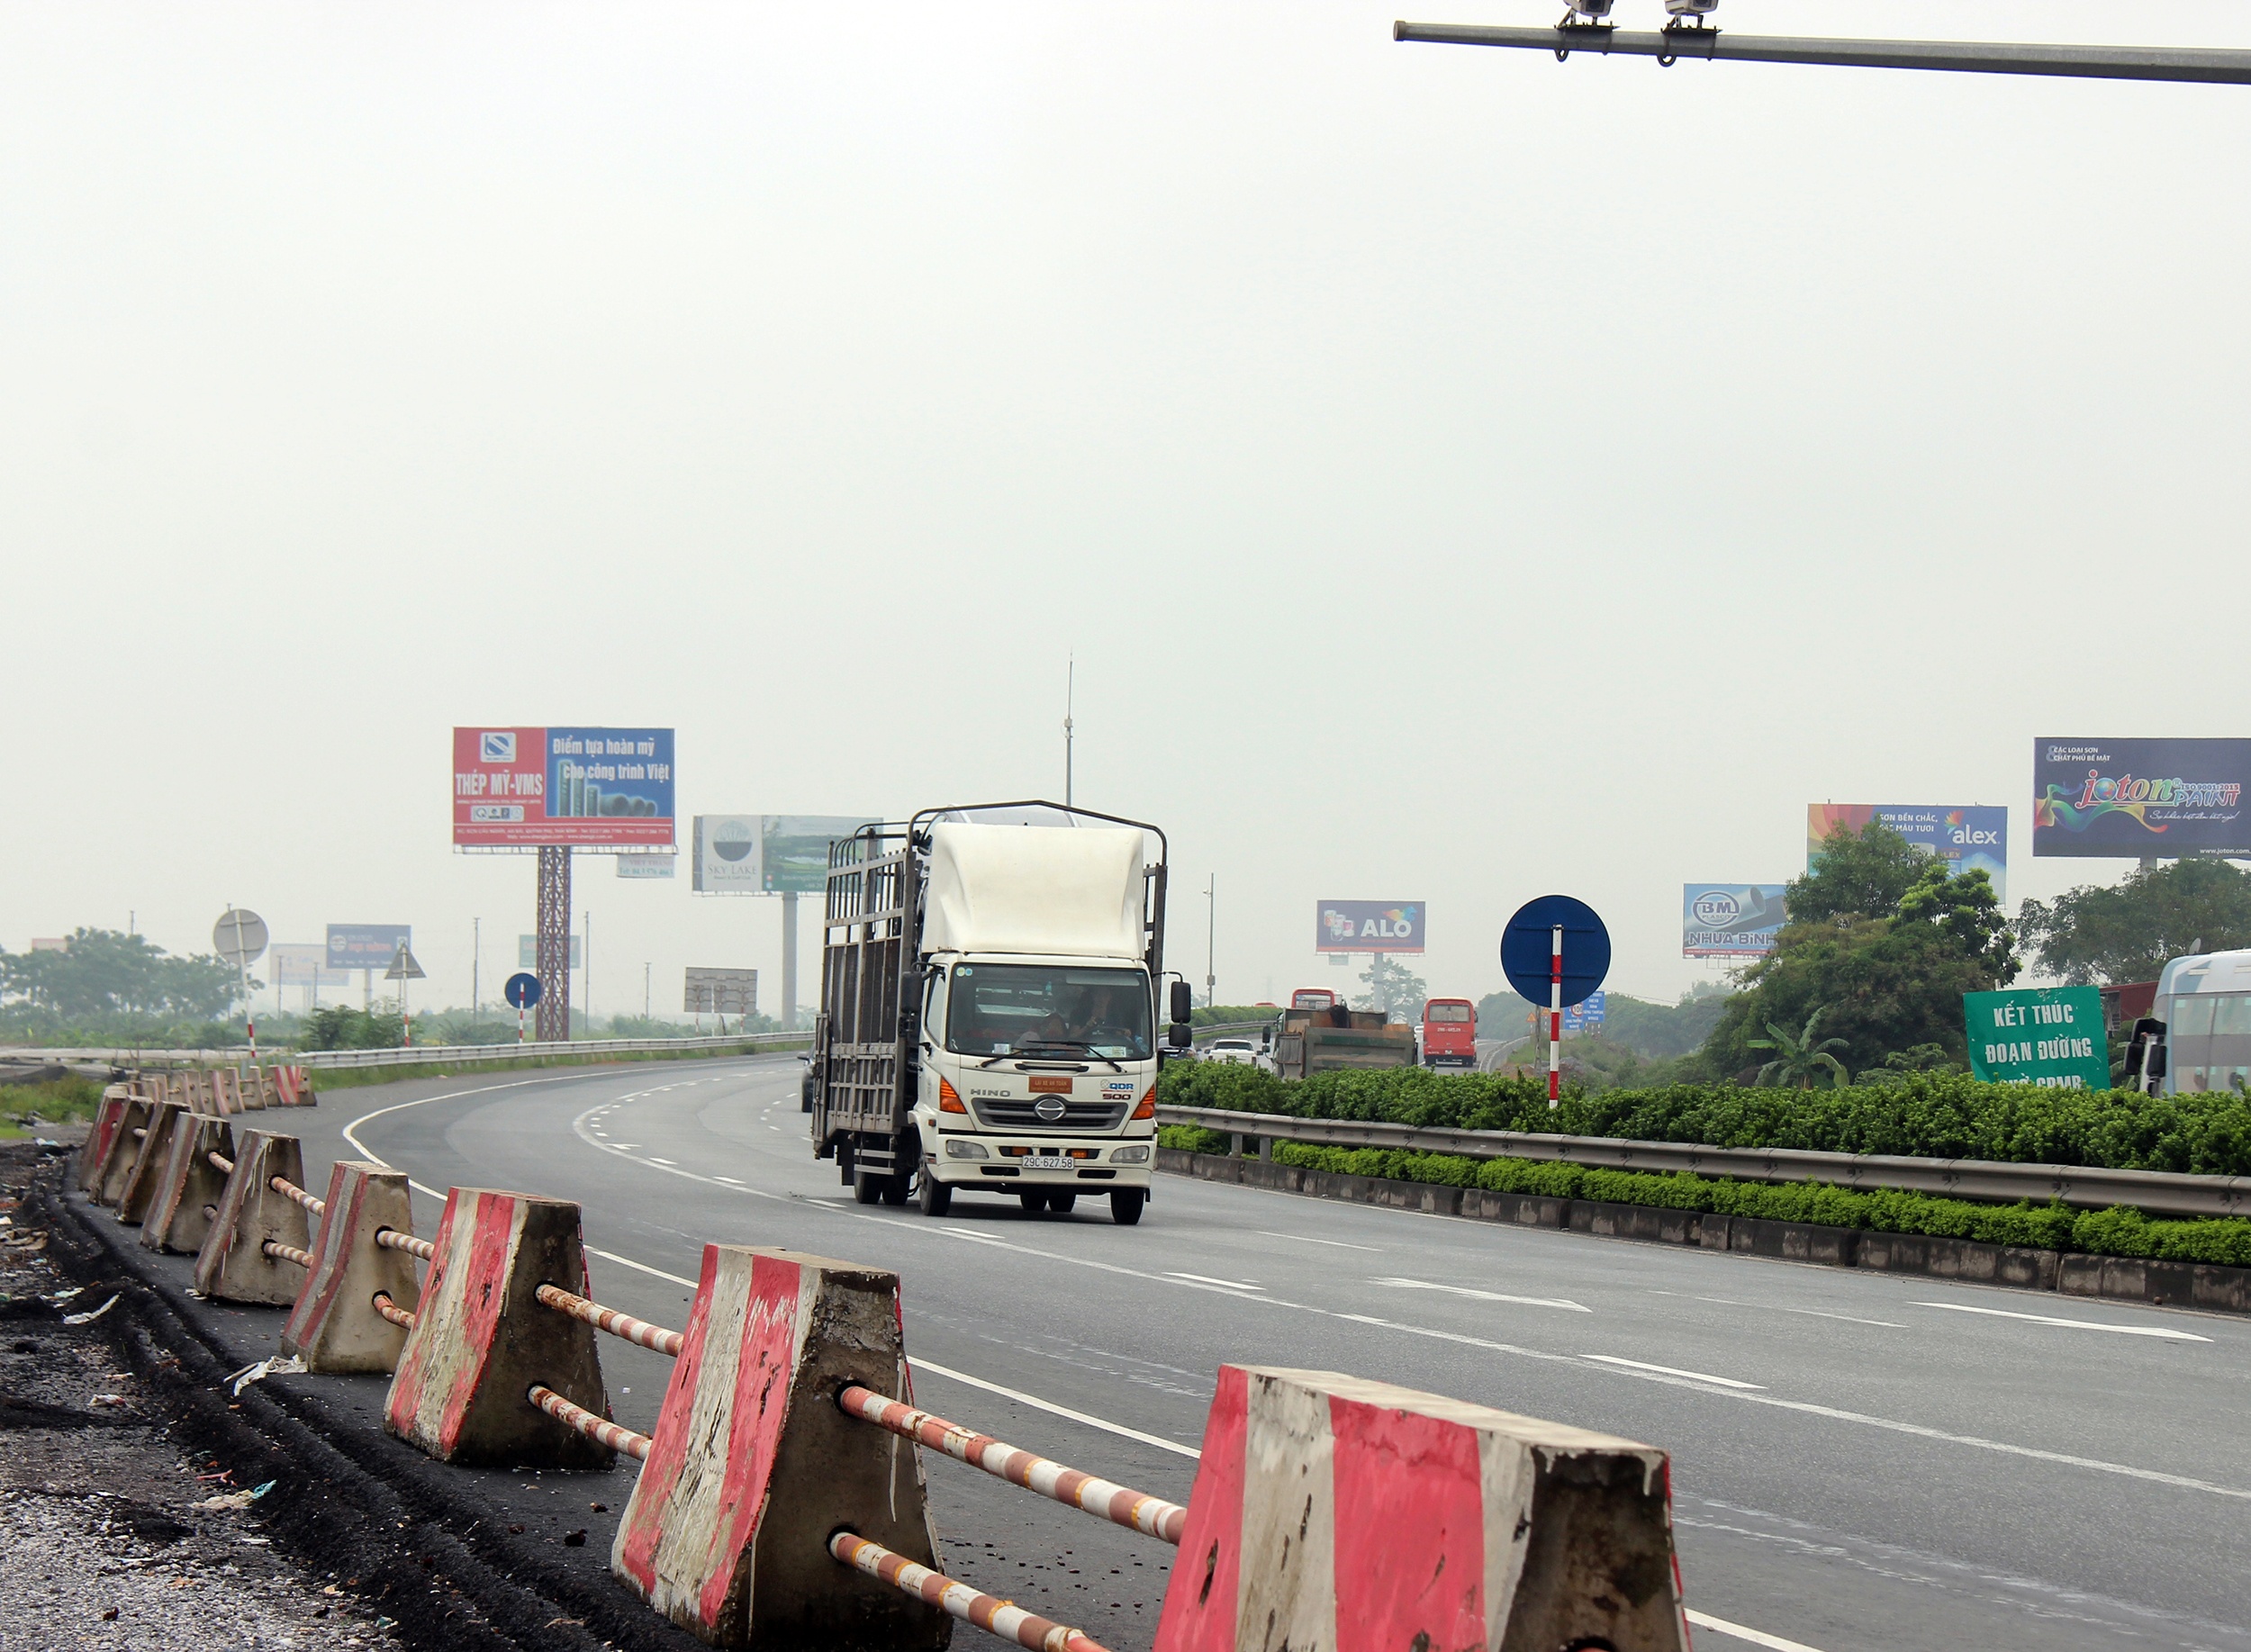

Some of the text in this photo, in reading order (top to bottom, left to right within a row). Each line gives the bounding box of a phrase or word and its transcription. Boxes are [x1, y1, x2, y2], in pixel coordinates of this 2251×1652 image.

[553, 735, 655, 758] Điểm tựa hoàn mỹ
[2067, 746, 2084, 754] LOẠI
[564, 763, 670, 783] cho công trình Việt
[455, 768, 544, 796] THÉP MỸ-VMS
[2181, 782, 2240, 791] ISO 9001:2015
[2173, 789, 2241, 808] PAINT
[1915, 824, 1934, 832] TƯƠI
[1952, 824, 1997, 844] alex
[708, 864, 757, 874] SKY LAKE
[1701, 901, 1732, 914] BM
[1361, 918, 1412, 938] ALO
[1688, 932, 1735, 948] NHỰA
[1993, 999, 2075, 1027] KẾT THÚC
[1984, 1034, 2093, 1066] ĐOẠN ĐƯỜNG
[970, 1088, 1011, 1097] HINO
[1108, 1082, 1135, 1090] QDR
